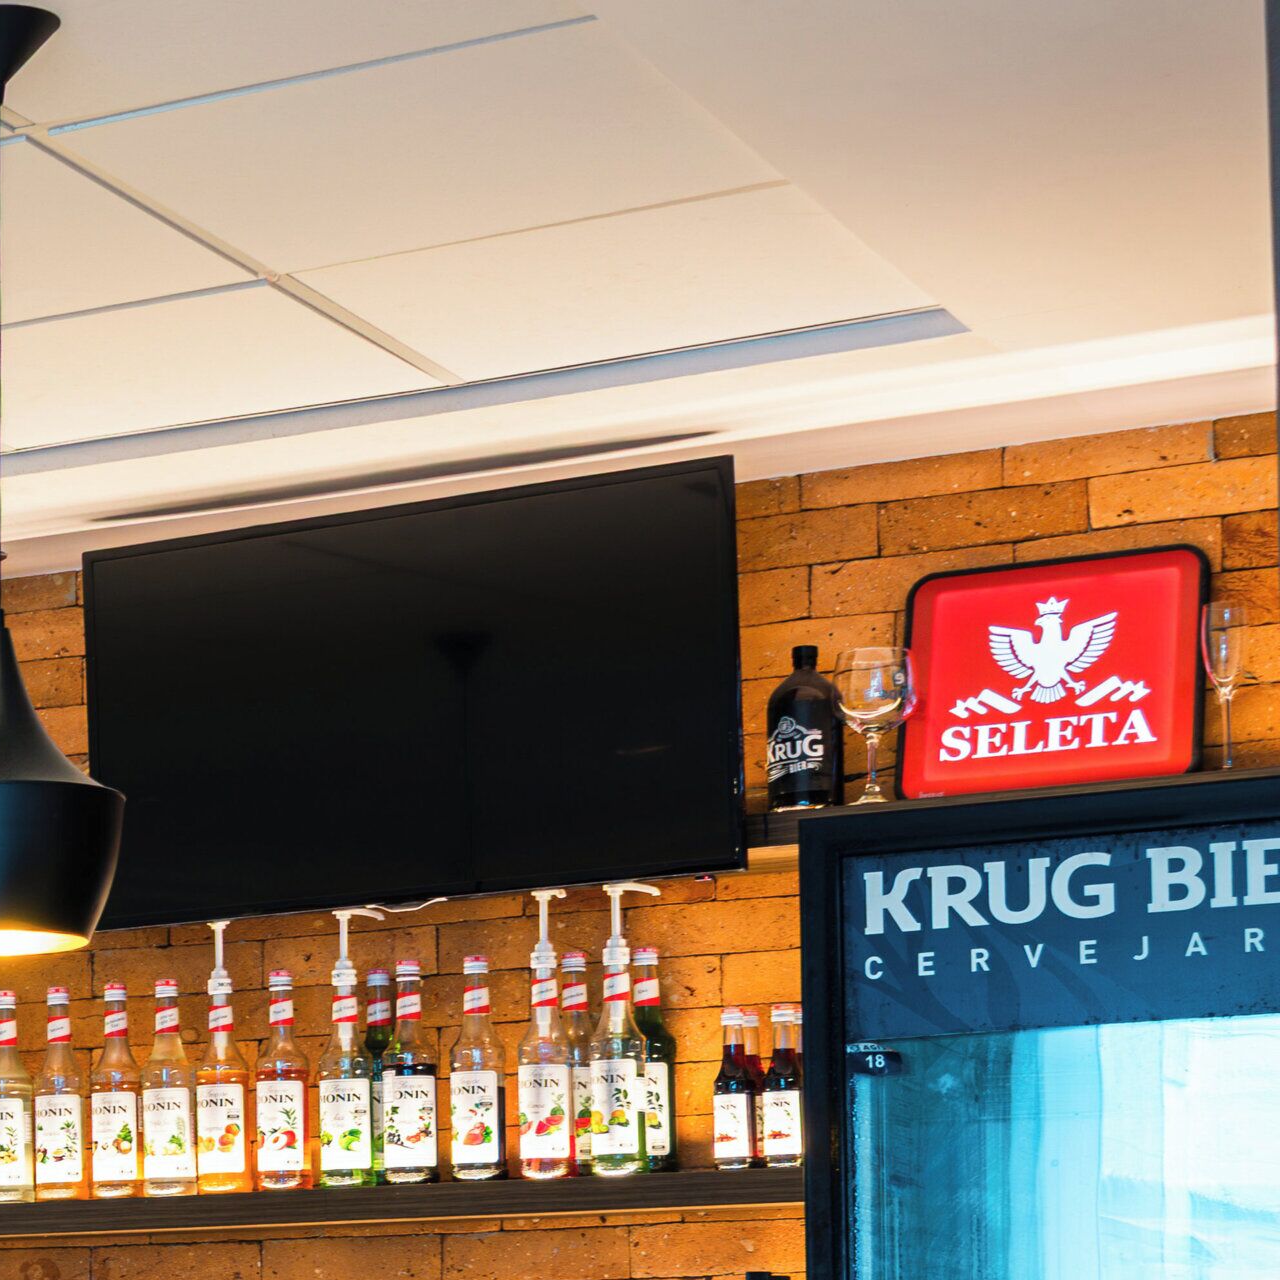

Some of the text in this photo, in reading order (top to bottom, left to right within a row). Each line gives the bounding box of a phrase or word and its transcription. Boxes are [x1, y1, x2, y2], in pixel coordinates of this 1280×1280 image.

[940, 708, 1157, 762] SELETA
[767, 734, 824, 763] KRUG
[864, 852, 1116, 936] KRUG
[865, 1054, 886, 1069] 18
[393, 1090, 429, 1100] ONIN
[453, 1085, 487, 1095] ONIN
[260, 1094, 295, 1104] ONIN
